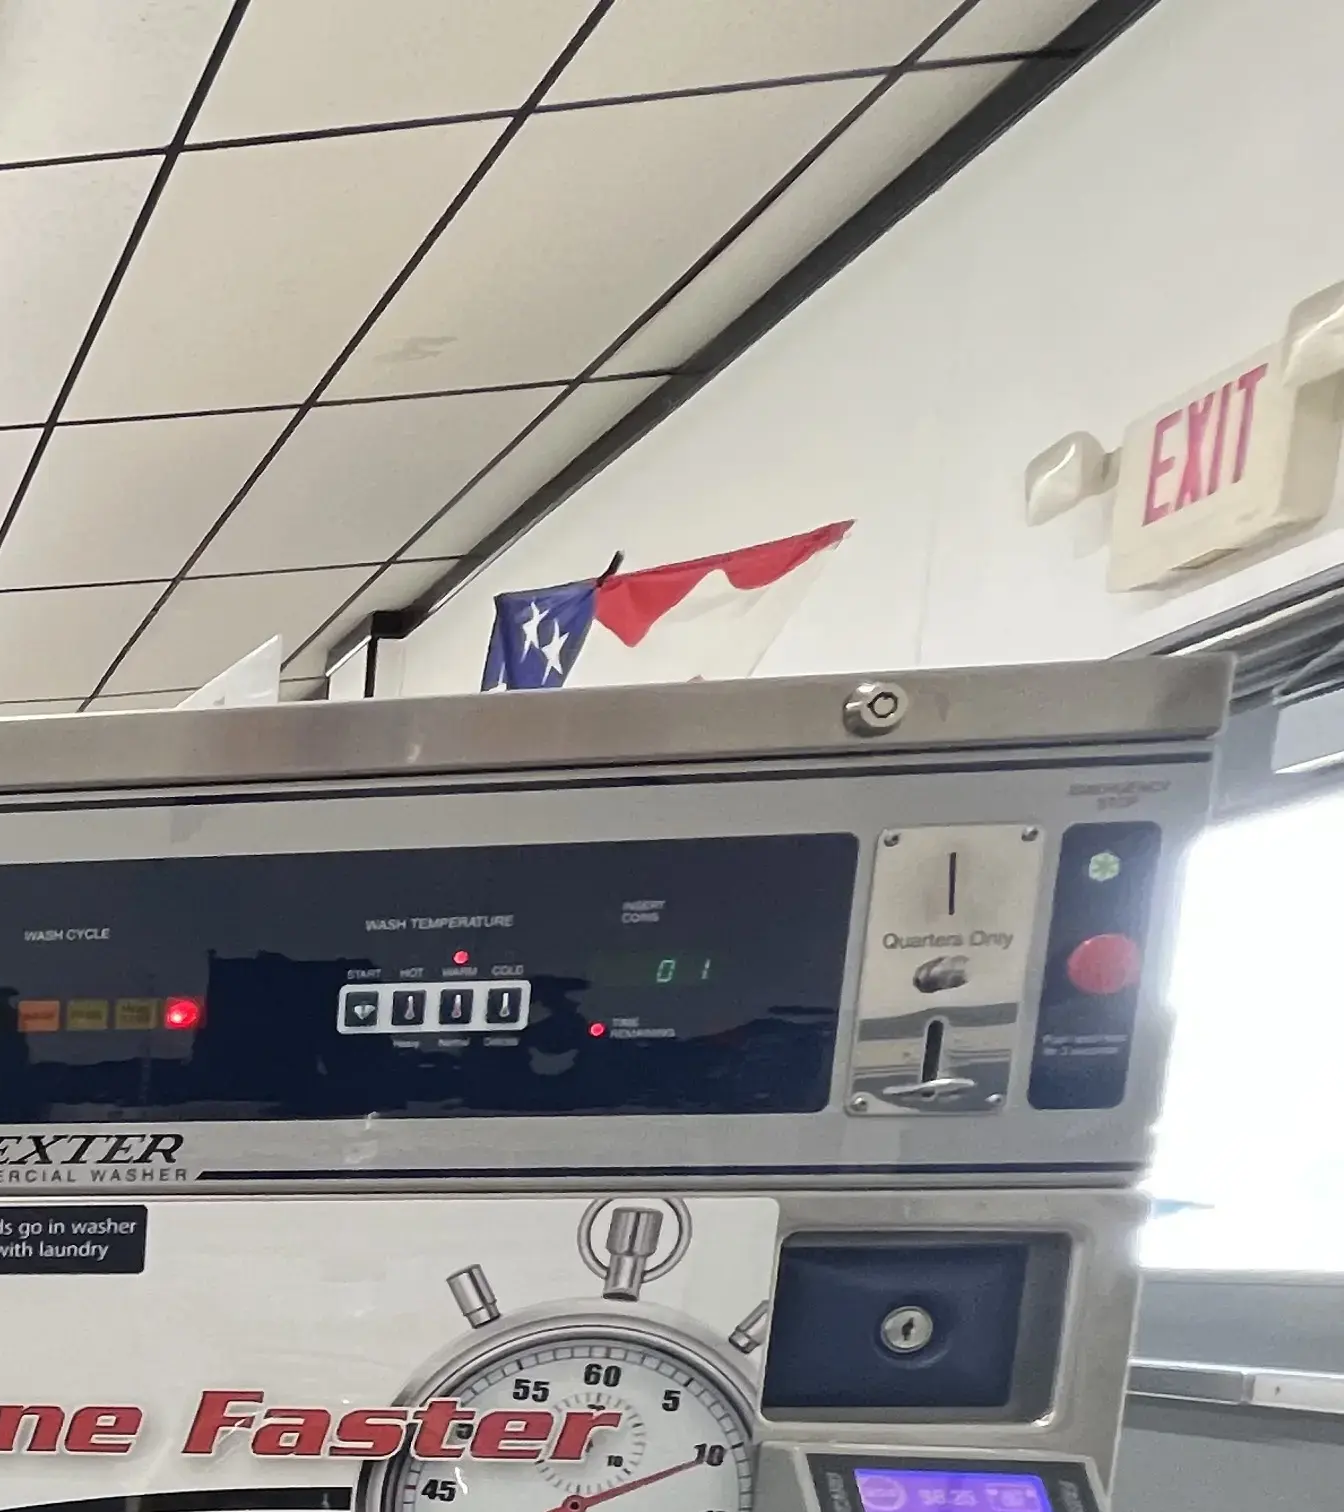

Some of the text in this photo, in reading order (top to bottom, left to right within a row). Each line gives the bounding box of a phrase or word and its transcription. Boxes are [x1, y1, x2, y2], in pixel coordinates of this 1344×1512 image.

[1142, 362, 1269, 527] EXIT
[364, 914, 514, 933] WASH TEMPERATURE
[24, 928, 111, 942] WASH CYCLE
[882, 931, 1014, 950] Quarters Only
[90, 1167, 190, 1182] WASHER
[18, 1222, 43, 1239] go
[48, 1218, 65, 1235] in
[71, 1217, 137, 1235] washer
[39, 1240, 109, 1262] laundry
[584, 1364, 621, 1387] 60
[512, 1379, 550, 1402] 55
[662, 1390, 681, 1412] 5
[182, 1390, 621, 1460] Faster
[694, 1442, 725, 1466] 10
[420, 1479, 457, 1503] 45
